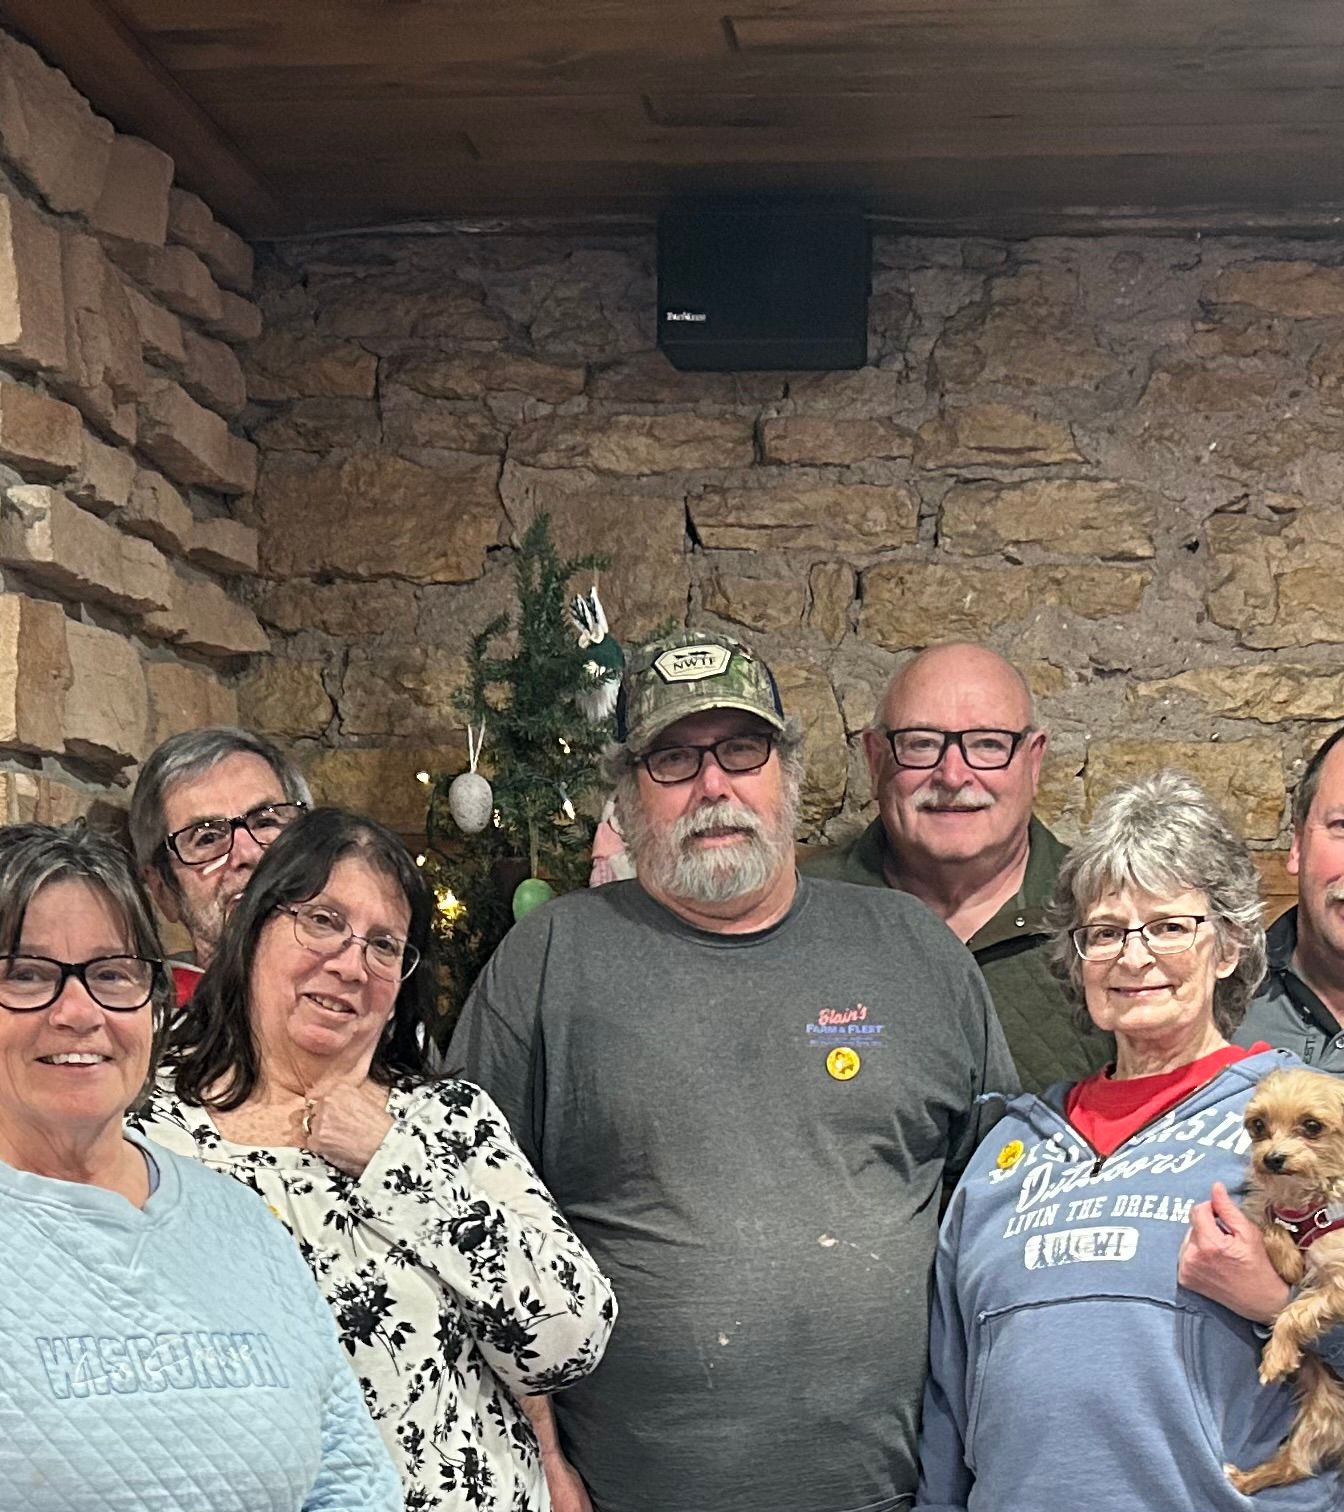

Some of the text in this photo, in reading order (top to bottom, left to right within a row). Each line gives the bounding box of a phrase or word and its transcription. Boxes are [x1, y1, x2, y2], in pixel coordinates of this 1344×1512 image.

[1003, 1194, 1195, 1239] LIVIN THE DREAM
